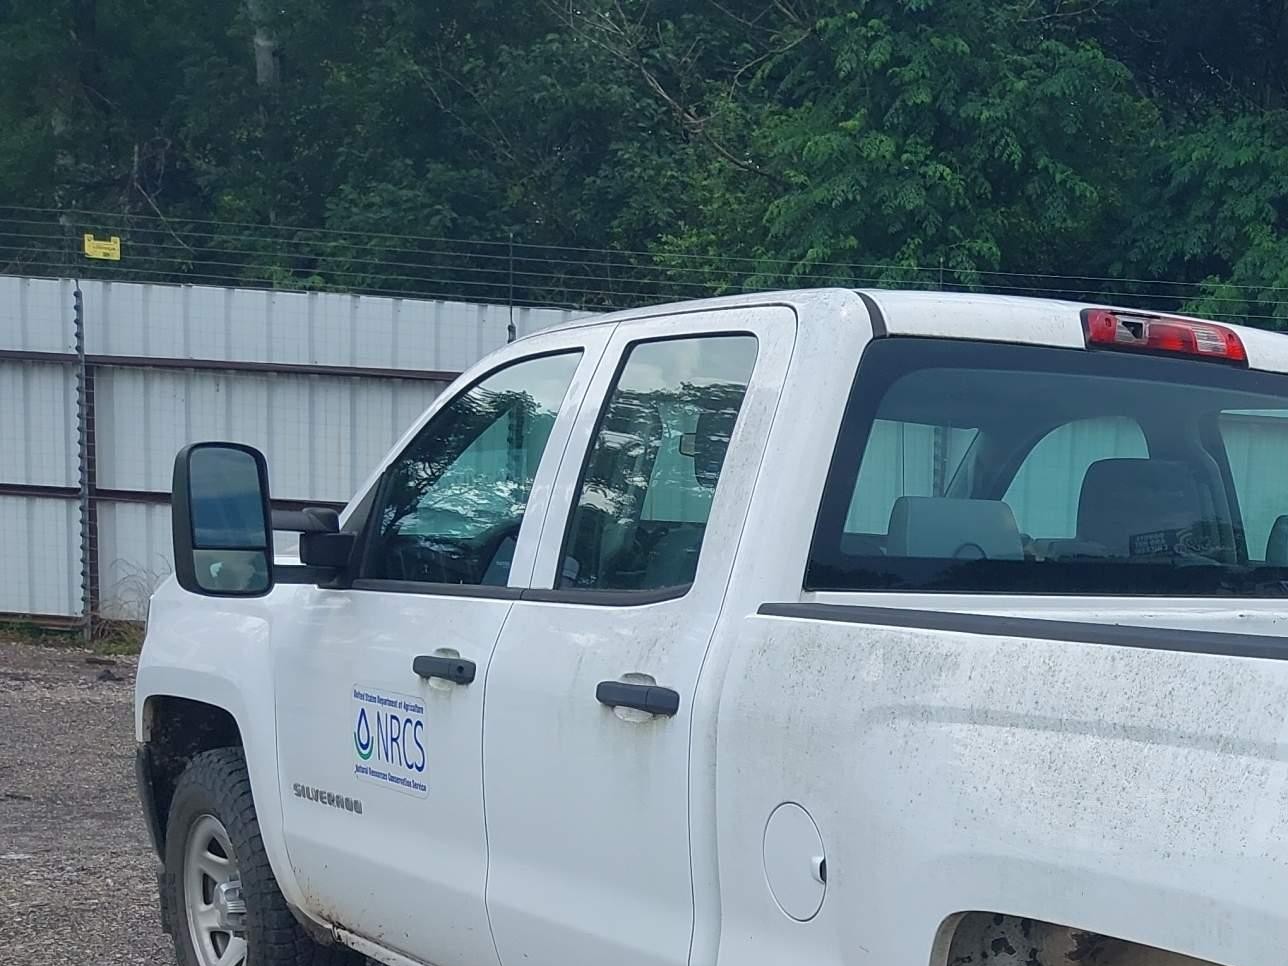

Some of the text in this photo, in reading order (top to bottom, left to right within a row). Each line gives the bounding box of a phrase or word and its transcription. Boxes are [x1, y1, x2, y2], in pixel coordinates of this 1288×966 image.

[377, 695, 398, 708] Department
[403, 700, 424, 714] Agriculture
[376, 711, 426, 773] NRCS
[293, 782, 363, 815] SILVERADO
[411, 779, 427, 792] Service
